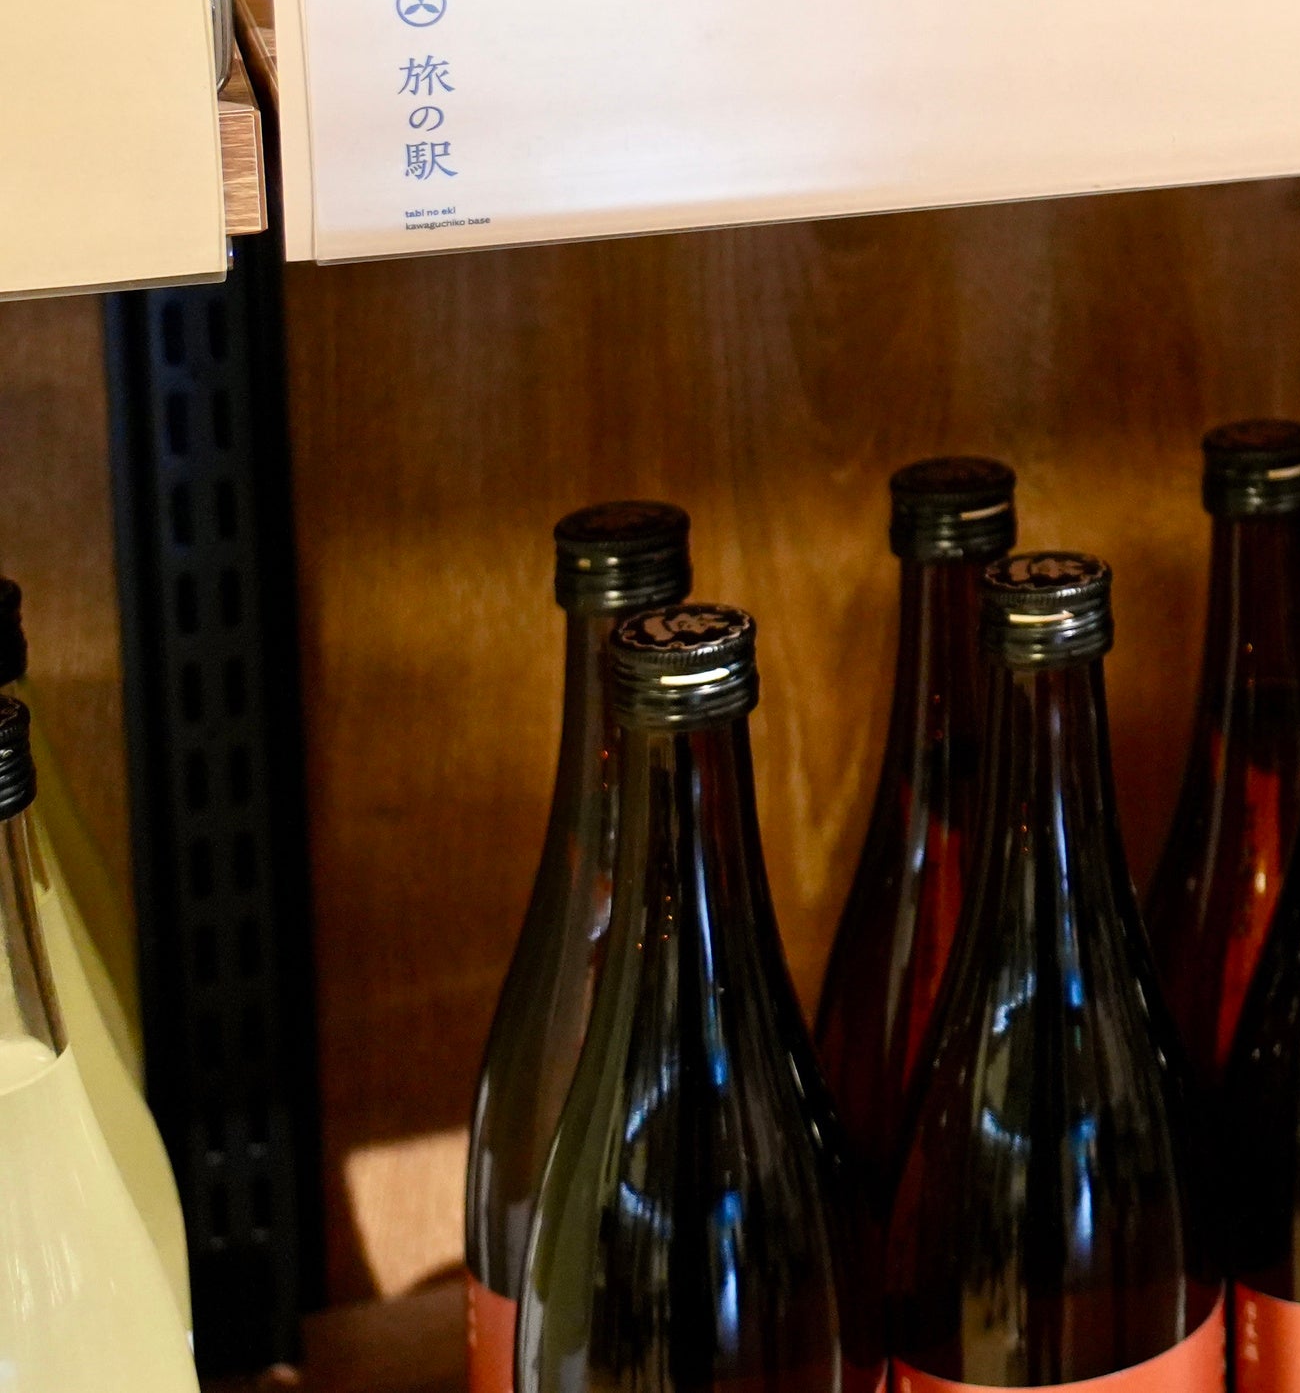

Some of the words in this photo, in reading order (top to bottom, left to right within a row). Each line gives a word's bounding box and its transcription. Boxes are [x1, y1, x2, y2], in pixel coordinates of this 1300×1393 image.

[397, 55, 459, 181] 旅の駅
[405, 209, 425, 218] tabi
[442, 206, 456, 215] eki
[405, 219, 466, 231] kawaguchiko
[468, 216, 491, 225] base
